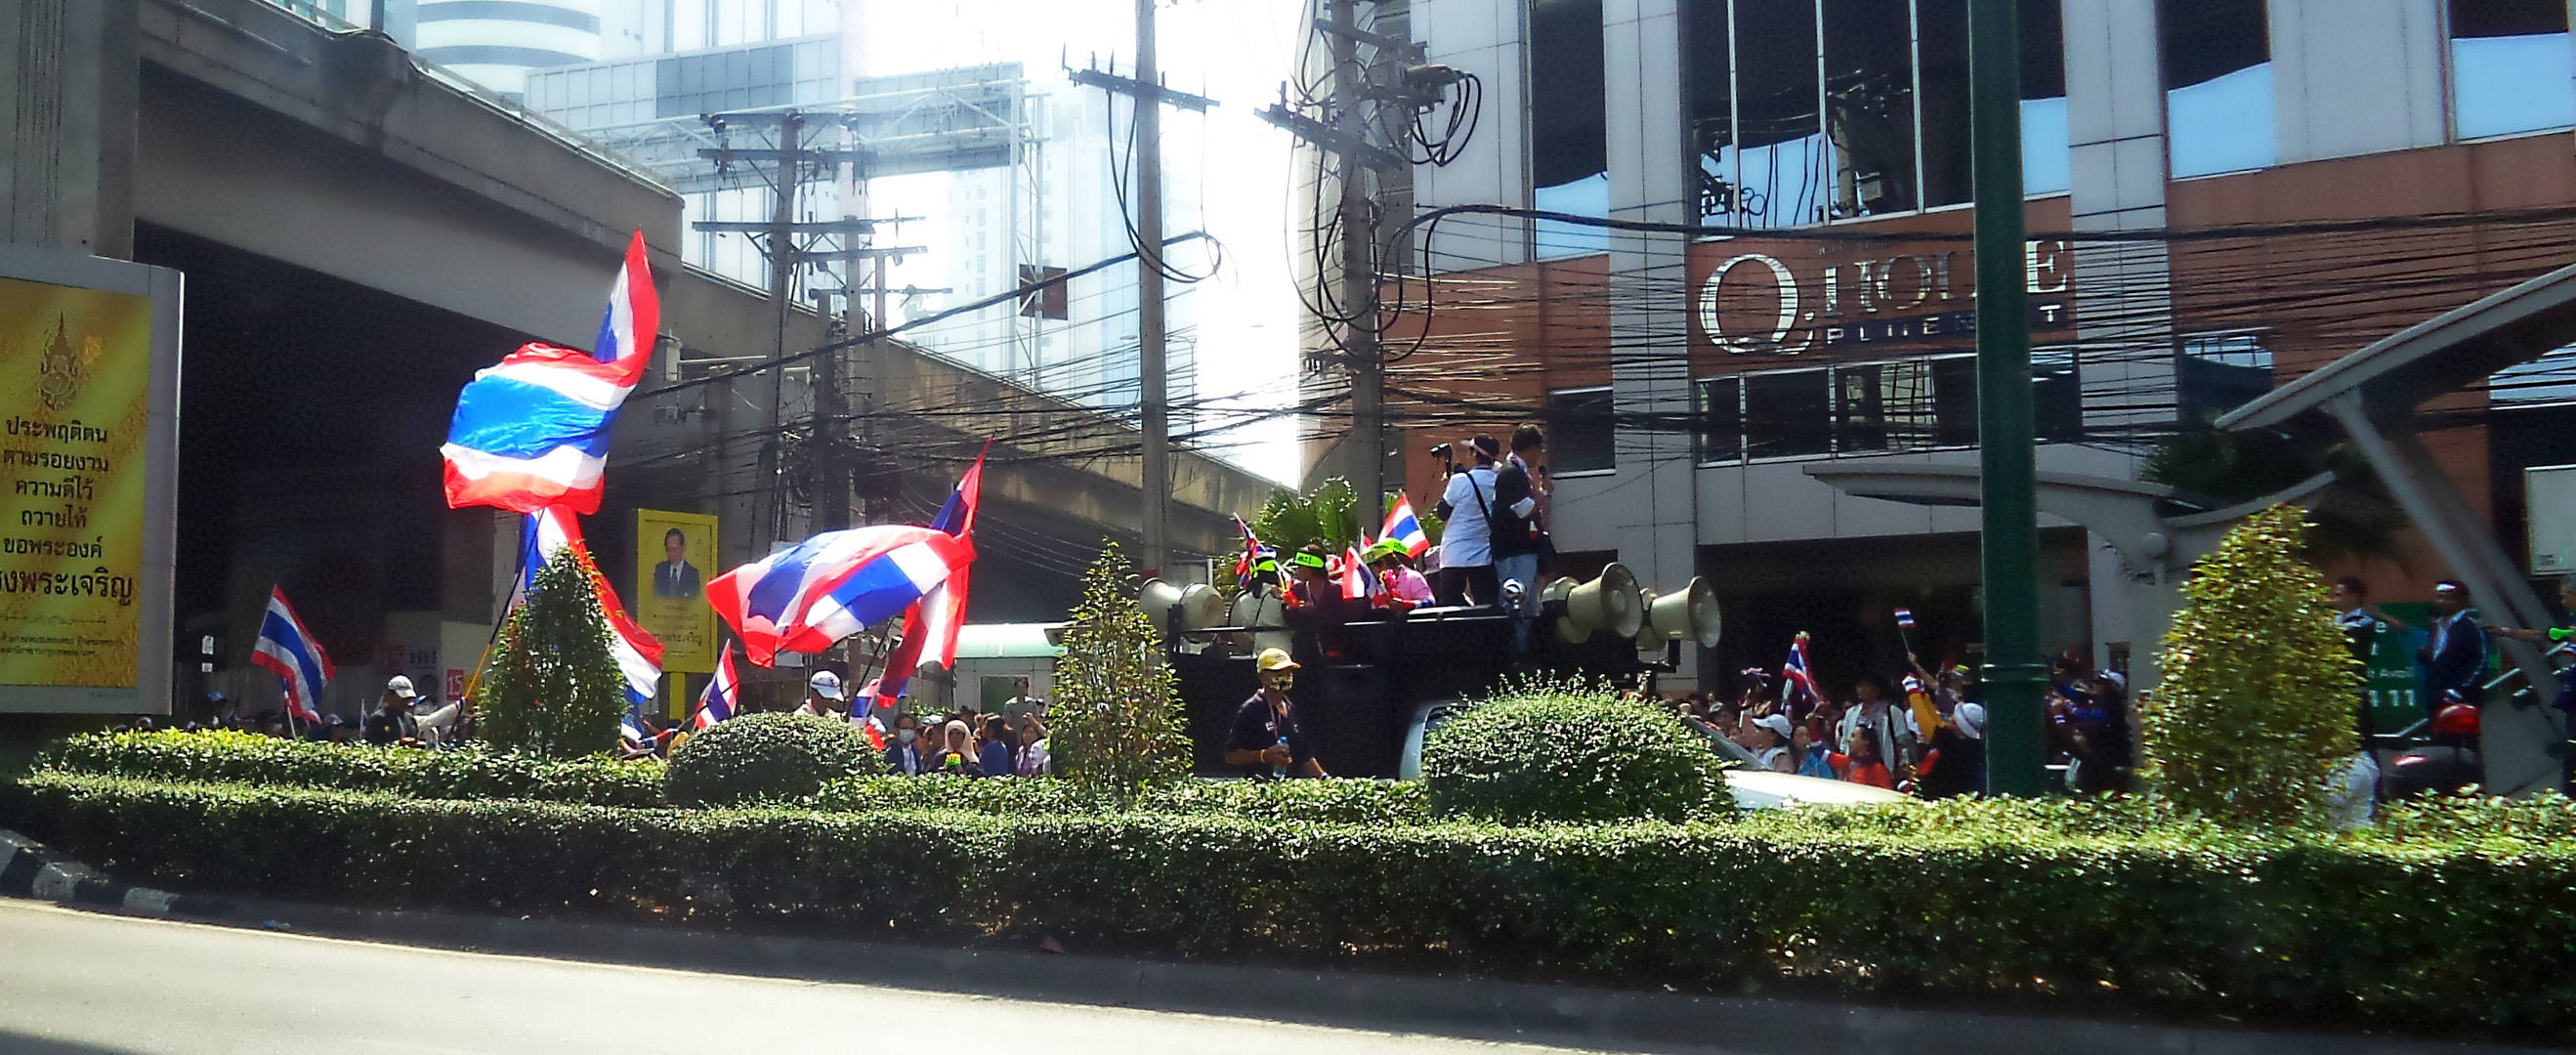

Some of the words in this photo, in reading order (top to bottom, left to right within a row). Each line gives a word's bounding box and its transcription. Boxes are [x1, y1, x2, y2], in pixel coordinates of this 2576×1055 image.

[6, 415, 107, 444] ประพฤติตน
[3, 449, 108, 472] ตามรอยงาม
[16, 475, 94, 500] ความดีไว้
[3, 535, 103, 559] ขอพระองค์
